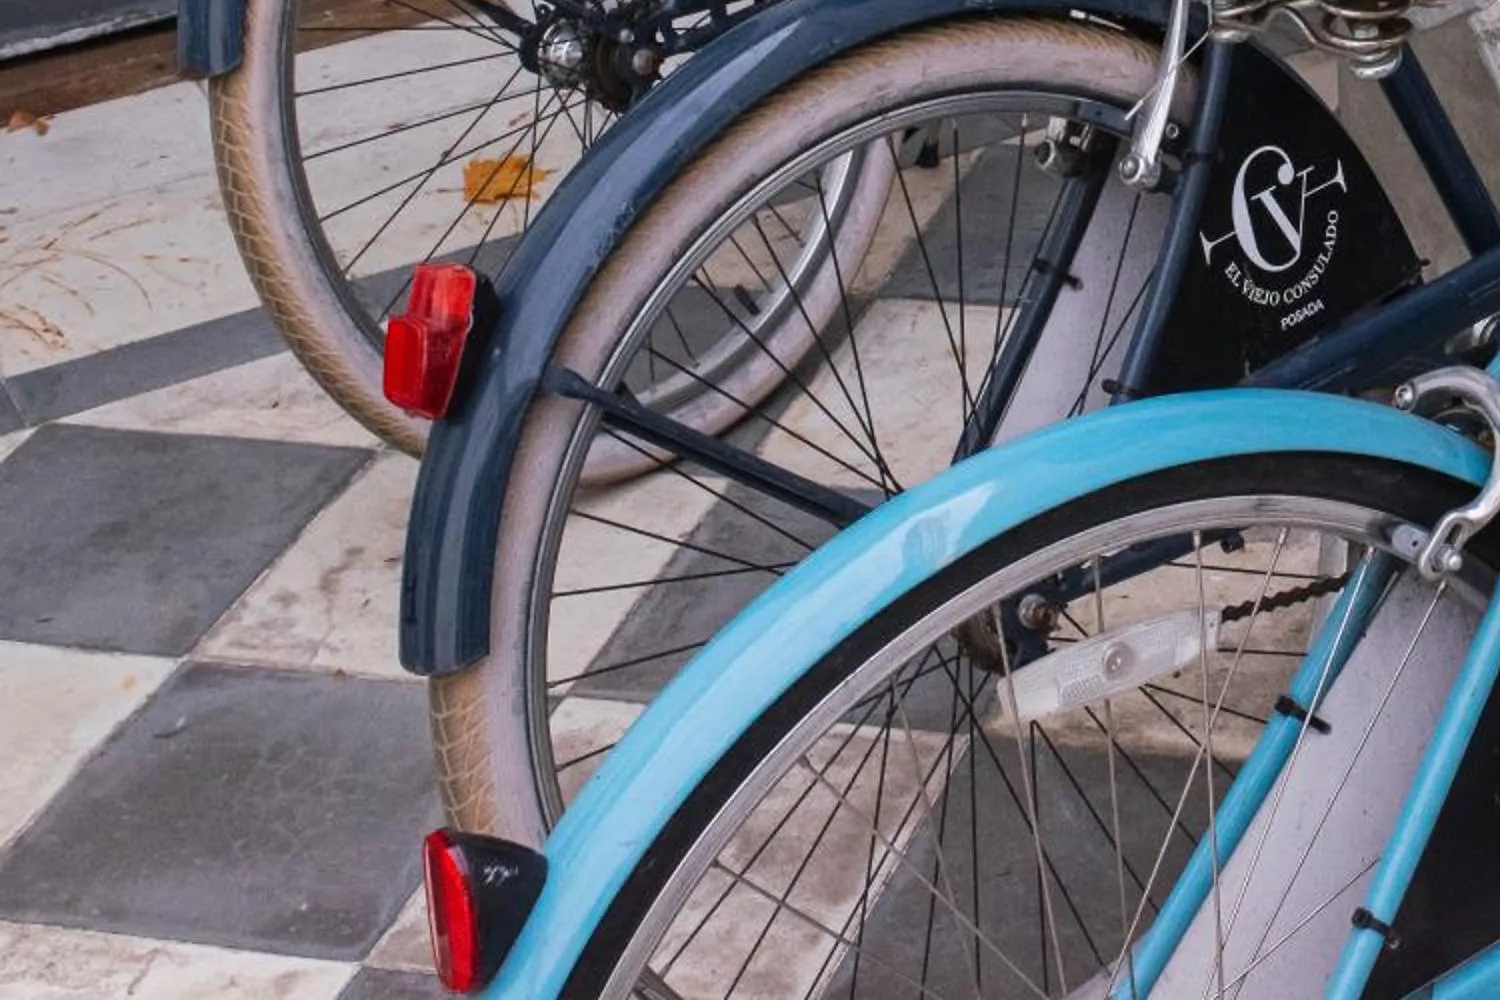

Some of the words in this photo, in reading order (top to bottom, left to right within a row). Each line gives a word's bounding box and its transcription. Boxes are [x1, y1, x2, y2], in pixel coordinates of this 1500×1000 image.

[1224, 261, 1242, 288] EL
[1241, 278, 1281, 307] VIEJO
[1283, 210, 1340, 305] CONSULADO
[1280, 298, 1326, 331] POSADA
